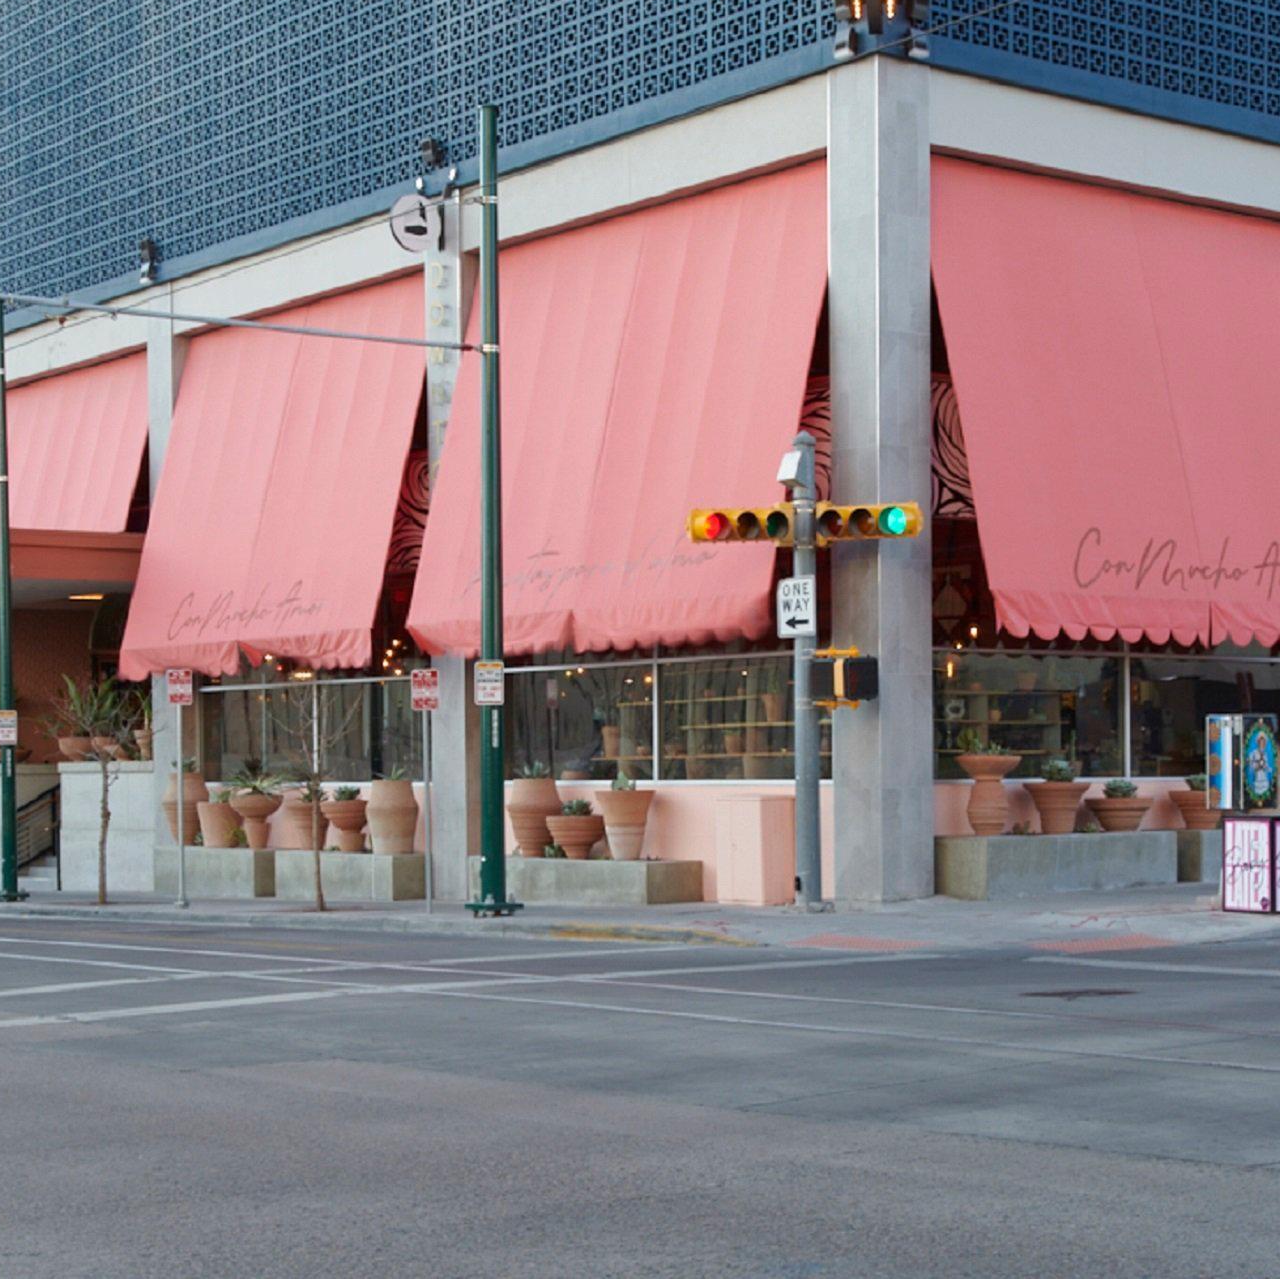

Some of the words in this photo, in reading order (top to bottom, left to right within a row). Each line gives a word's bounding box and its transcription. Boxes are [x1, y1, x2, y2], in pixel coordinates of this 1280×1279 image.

[1073, 527, 1135, 588] Con
[782, 582, 809, 597] ONE
[783, 598, 810, 612] WAY
